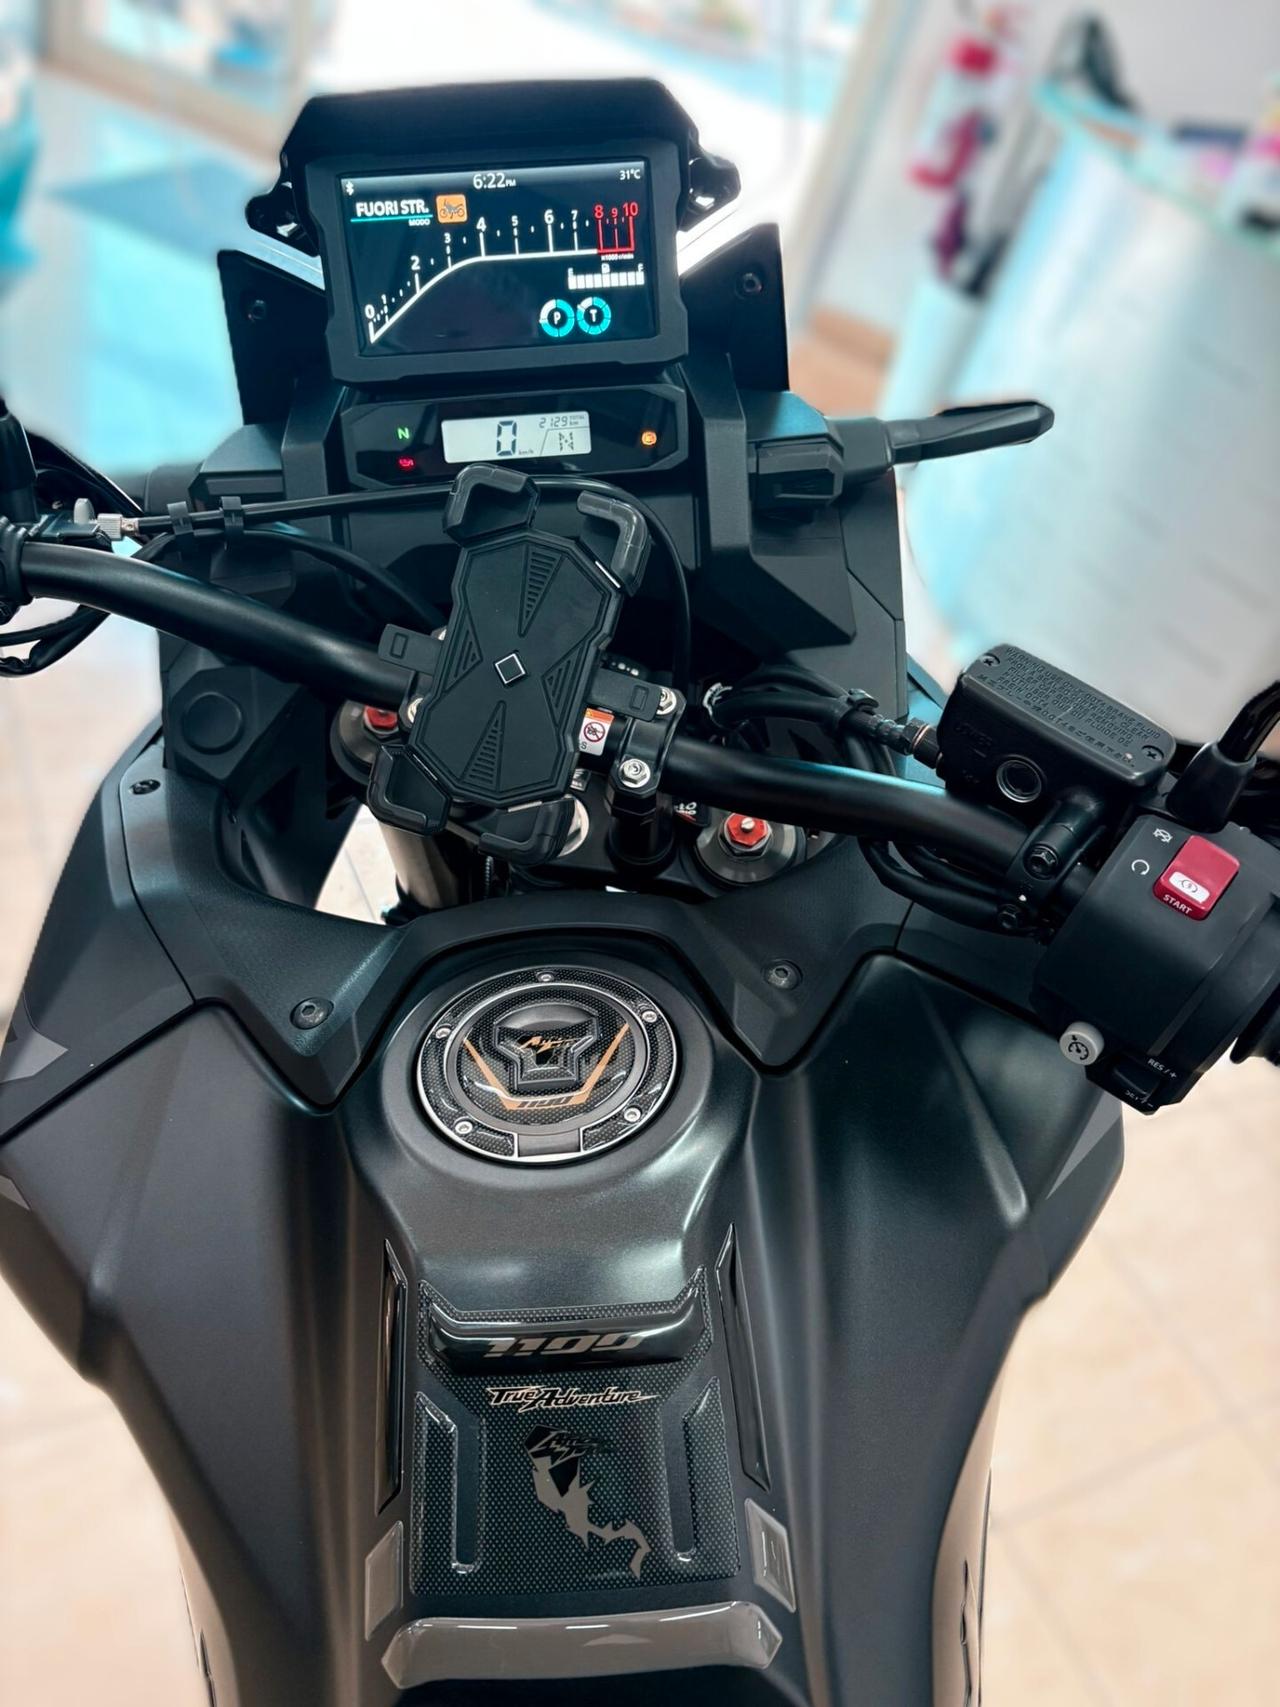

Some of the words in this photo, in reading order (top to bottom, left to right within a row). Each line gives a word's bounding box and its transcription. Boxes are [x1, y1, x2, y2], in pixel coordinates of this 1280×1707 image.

[620, 168, 641, 180] 31°C
[356, 201, 398, 217] FUORI
[400, 199, 429, 215] STR.
[571, 209, 578, 221] 7
[594, 204, 604, 219] 8
[611, 207, 618, 218] 9
[622, 201, 639, 217] 10
[408, 218, 430, 226] MODO
[476, 216, 487, 232] 4
[511, 215, 519, 227] 5
[544, 209, 554, 225] 6
[444, 232, 451, 244] 3
[410, 255, 421, 271] 2
[364, 304, 375, 320] 0
[553, 311, 561, 325] P
[589, 309, 598, 323] T
[539, 416, 568, 428] 2129
[397, 427, 410, 440] N
[496, 420, 517, 456] 0
[1134, 722, 1161, 738] FLUID
[580, 741, 588, 751] S
[1162, 893, 1193, 914] START
[485, 1384, 547, 1406] True
[518, 1385, 661, 1414] Adventure
